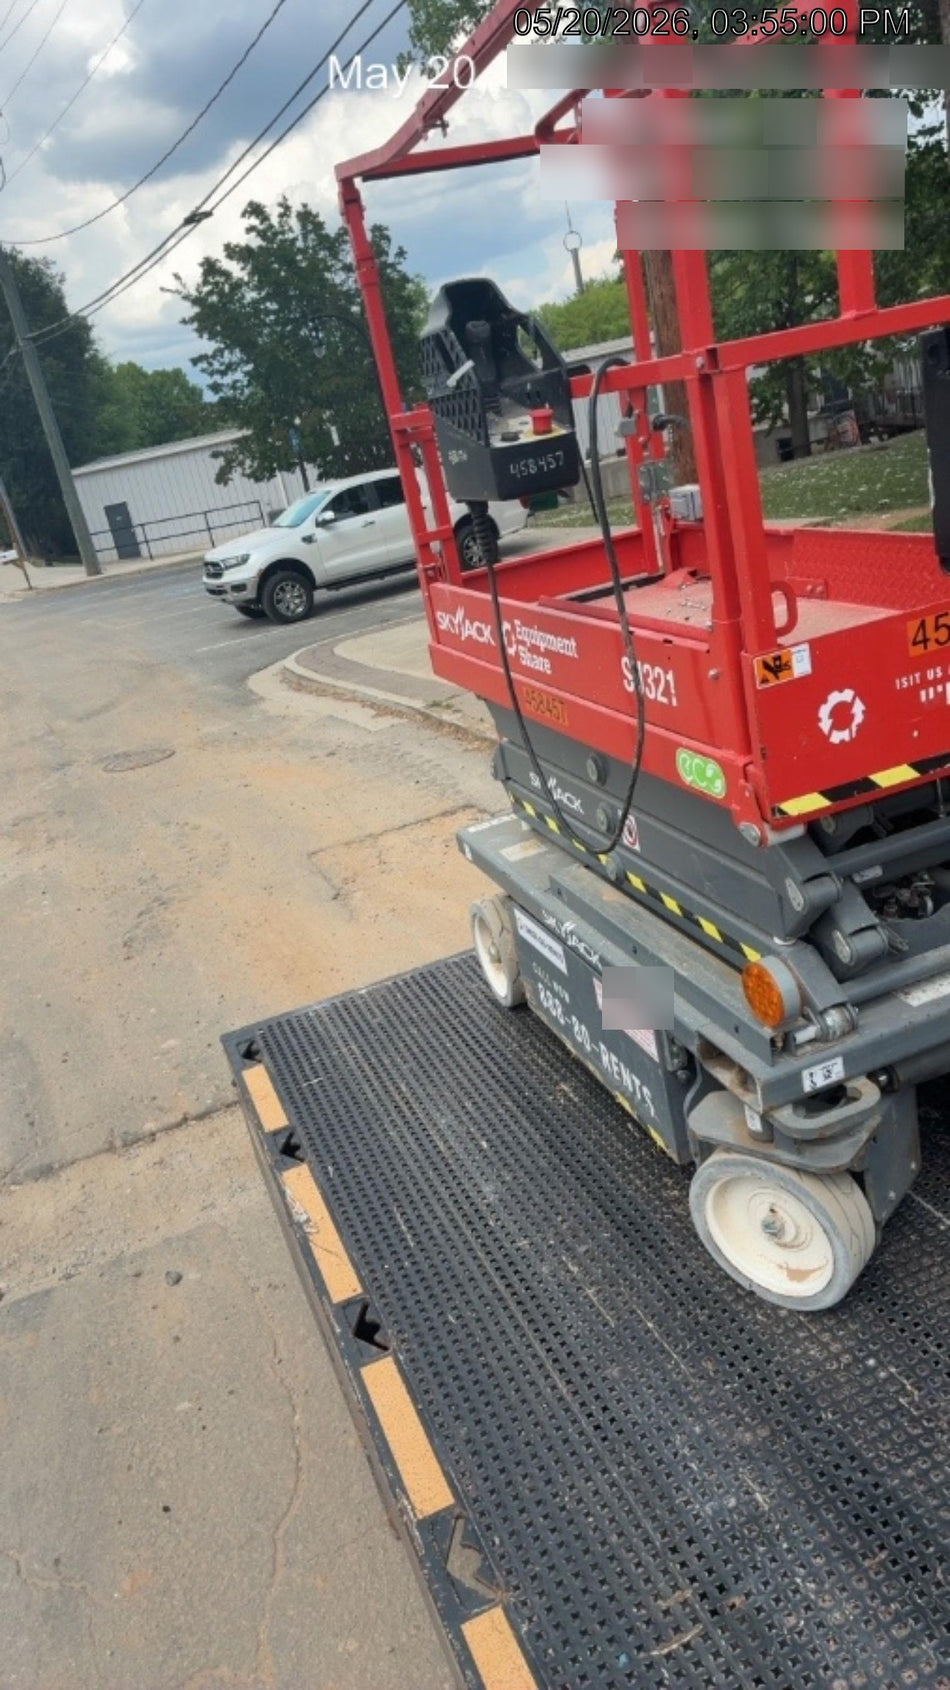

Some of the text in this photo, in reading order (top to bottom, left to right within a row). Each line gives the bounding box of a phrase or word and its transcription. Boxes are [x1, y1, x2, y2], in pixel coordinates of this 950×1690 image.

[510, 451, 564, 478] 458457
[436, 605, 496, 646] SKYJACK
[514, 619, 579, 658] Equipment
[518, 645, 552, 675] Share
